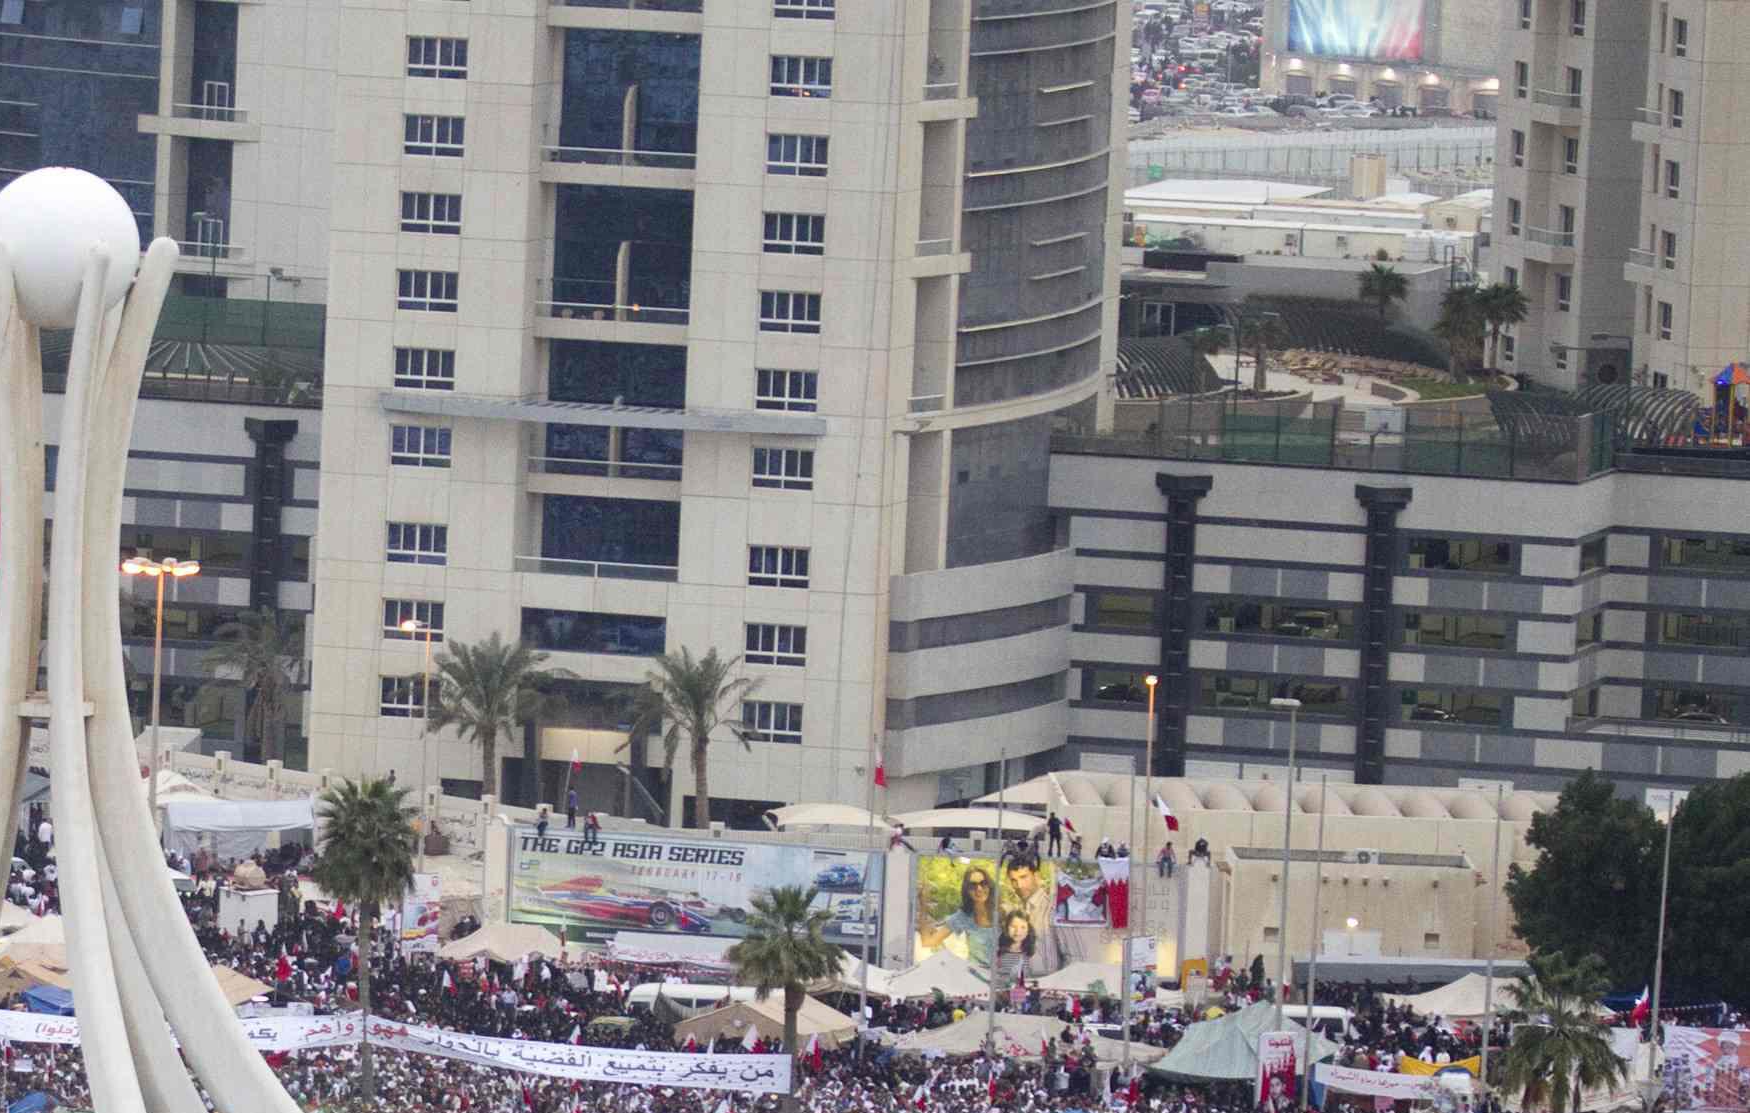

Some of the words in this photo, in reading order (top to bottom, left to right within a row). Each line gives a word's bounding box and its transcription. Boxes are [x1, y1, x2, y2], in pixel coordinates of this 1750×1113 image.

[521, 836, 561, 854] THE
[565, 838, 606, 858] GP2
[611, 842, 663, 861] ASIA
[668, 846, 746, 867] SERIES
[631, 865, 697, 880] FEBRUARY
[418, 1035, 501, 1057] بالحوار
[510, 1044, 593, 1069] القضية
[678, 1062, 728, 1081] يفكر
[739, 1065, 775, 1082] من
